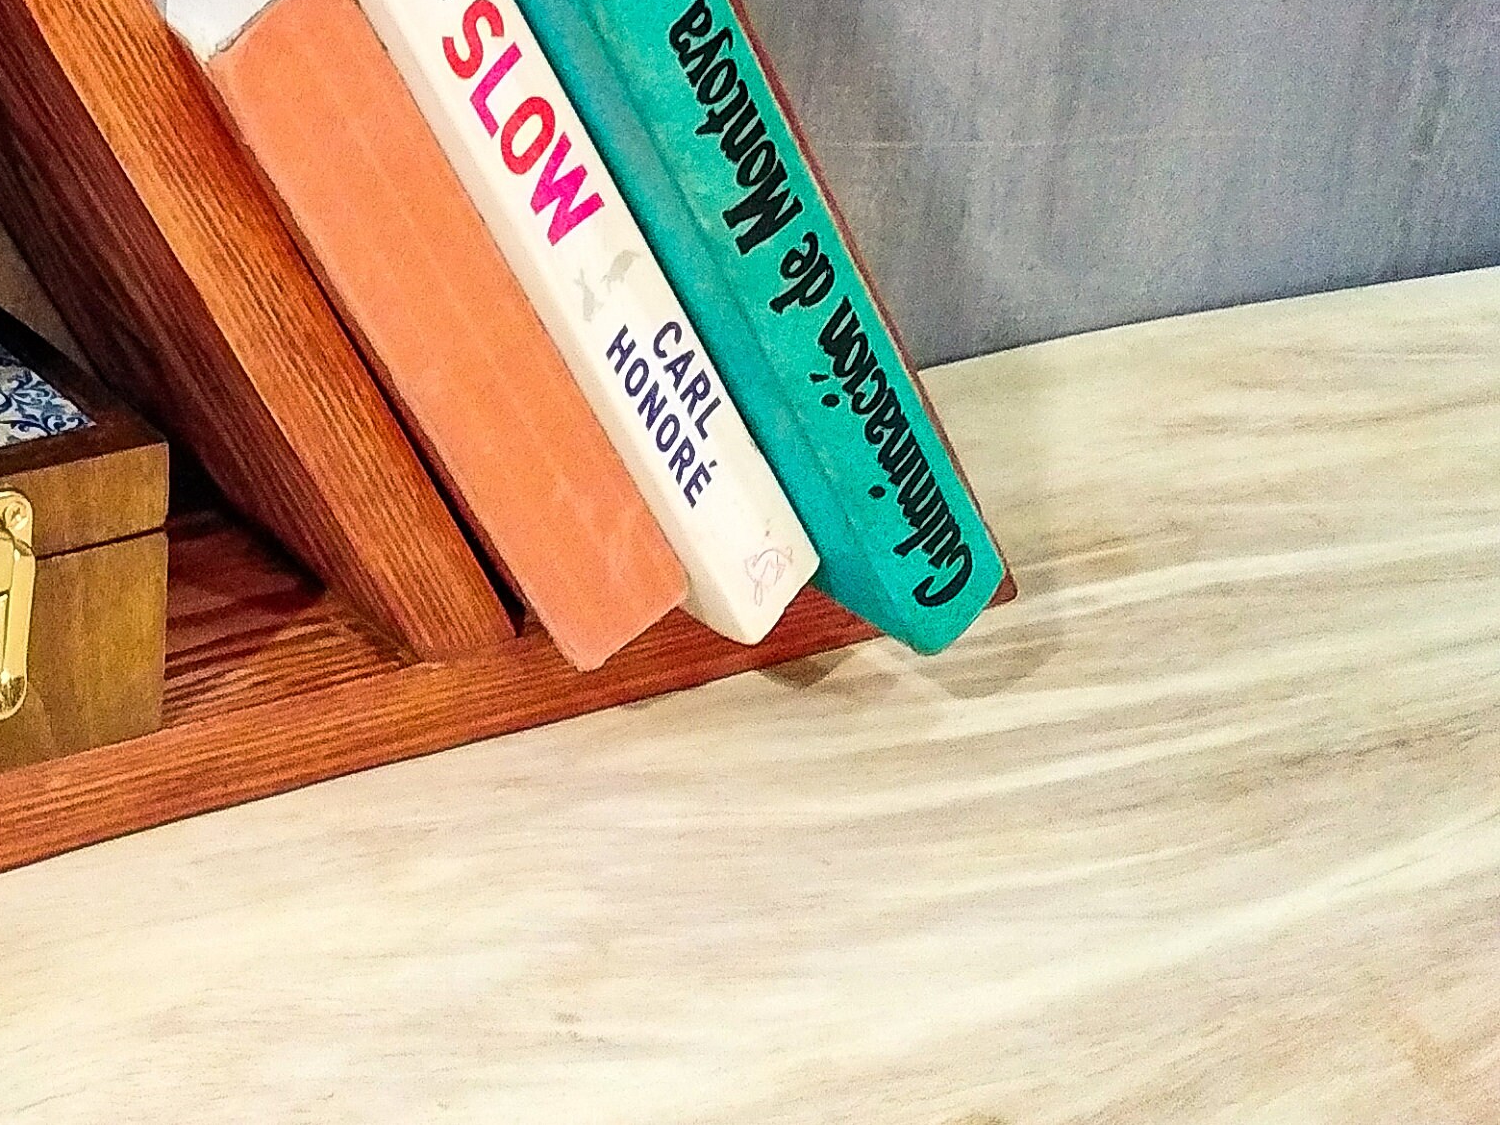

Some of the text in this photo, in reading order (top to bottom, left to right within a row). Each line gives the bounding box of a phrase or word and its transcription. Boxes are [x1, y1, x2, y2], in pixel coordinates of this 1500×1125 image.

[768, 231, 835, 315] de
[606, 324, 718, 509] HONORÉ
[653, 321, 722, 441] CARL
[809, 295, 974, 608] Culminación
